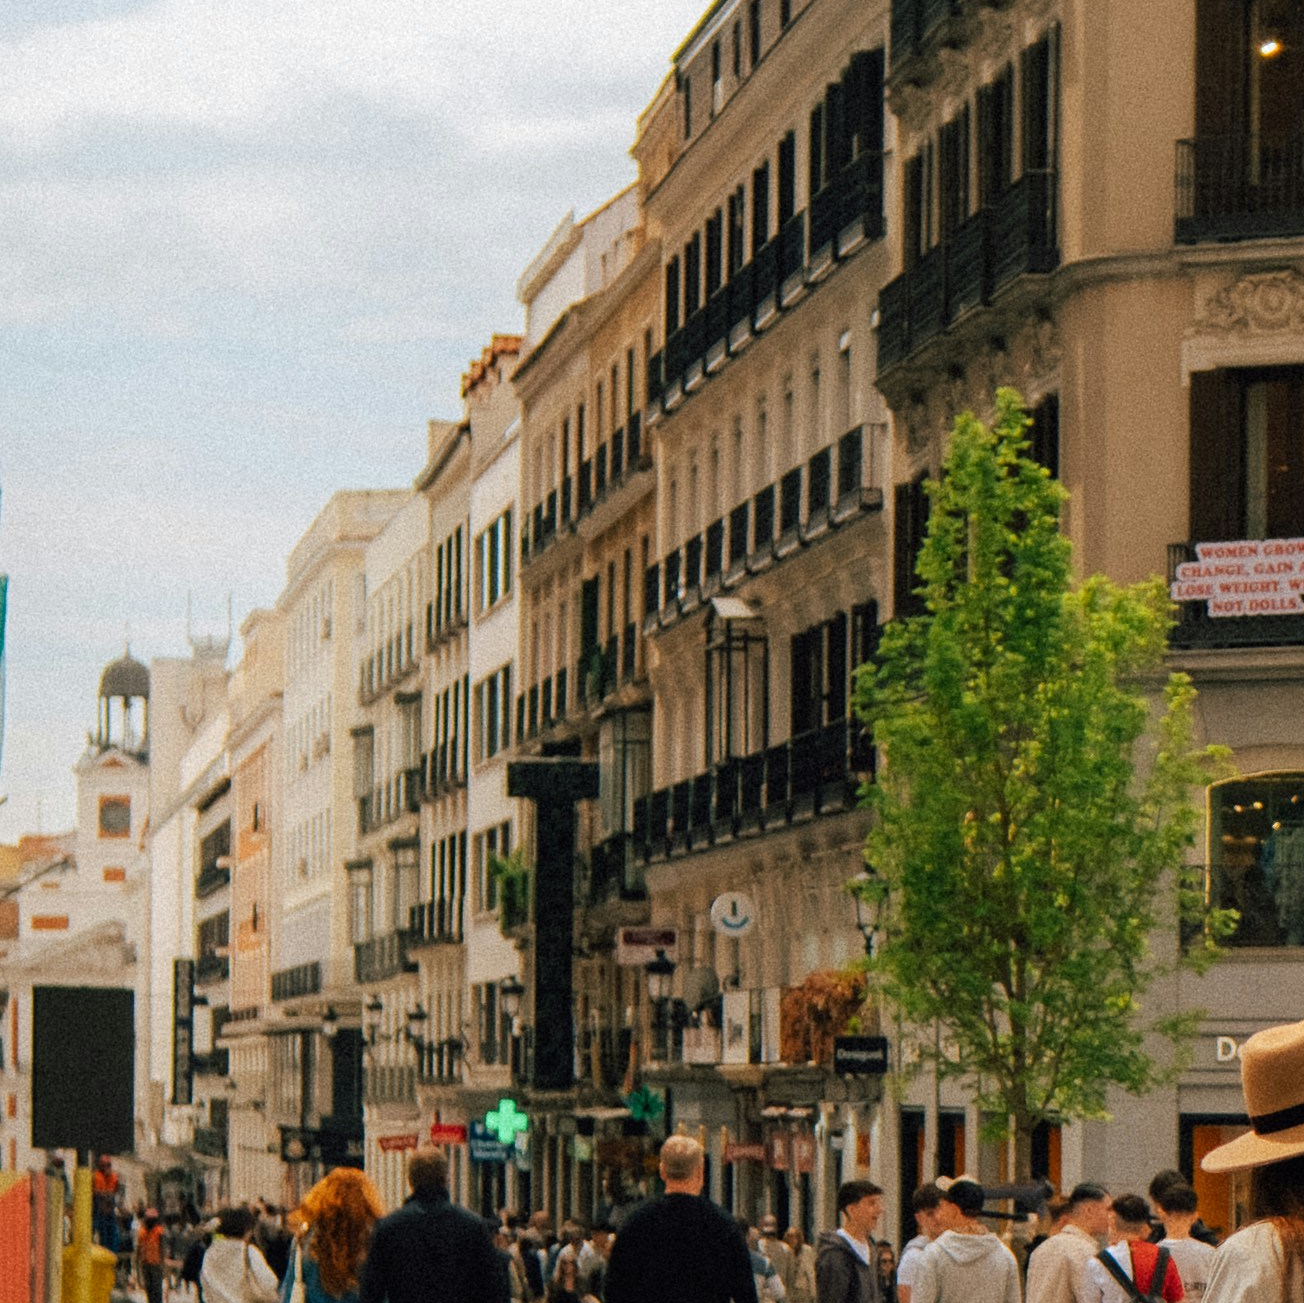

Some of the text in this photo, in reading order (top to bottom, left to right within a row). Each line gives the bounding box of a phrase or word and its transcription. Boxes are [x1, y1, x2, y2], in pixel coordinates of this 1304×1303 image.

[1200, 544, 1258, 559] WOMEN
[1254, 560, 1294, 574] GAIN
[1176, 583, 1213, 597] LOSE
[1213, 600, 1244, 612] NOT
